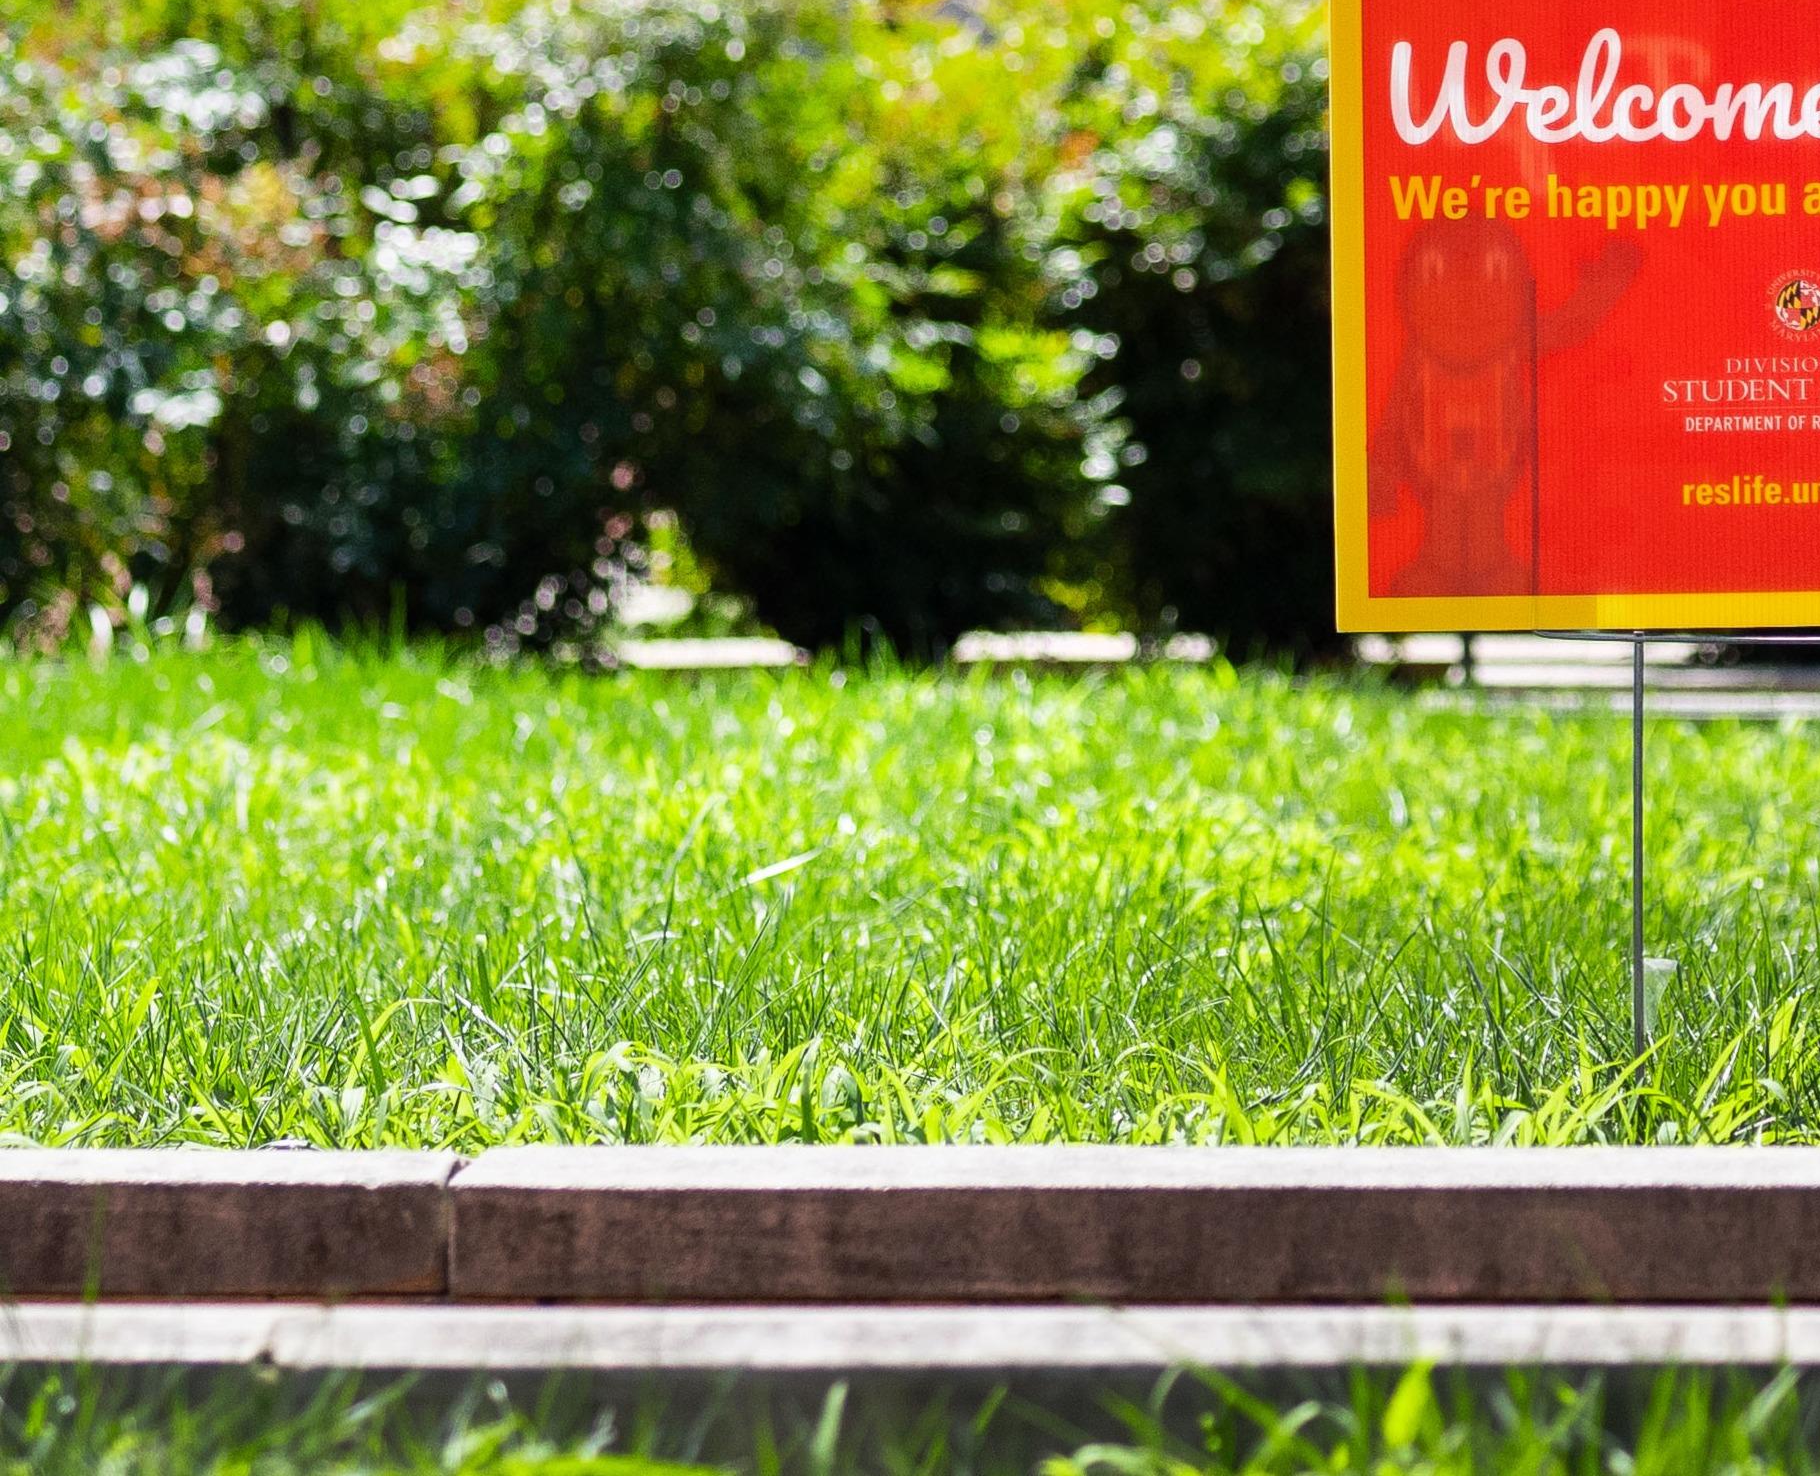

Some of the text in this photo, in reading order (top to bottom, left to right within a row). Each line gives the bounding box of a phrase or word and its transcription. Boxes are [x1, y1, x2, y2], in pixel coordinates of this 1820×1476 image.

[1388, 174, 1531, 220] We're
[1546, 173, 1690, 230] happy
[1702, 181, 1787, 228] you
[1662, 378, 1814, 403] STUDENT
[1685, 415, 1782, 432] DEPARTMENT
[1787, 414, 1807, 431] OF
